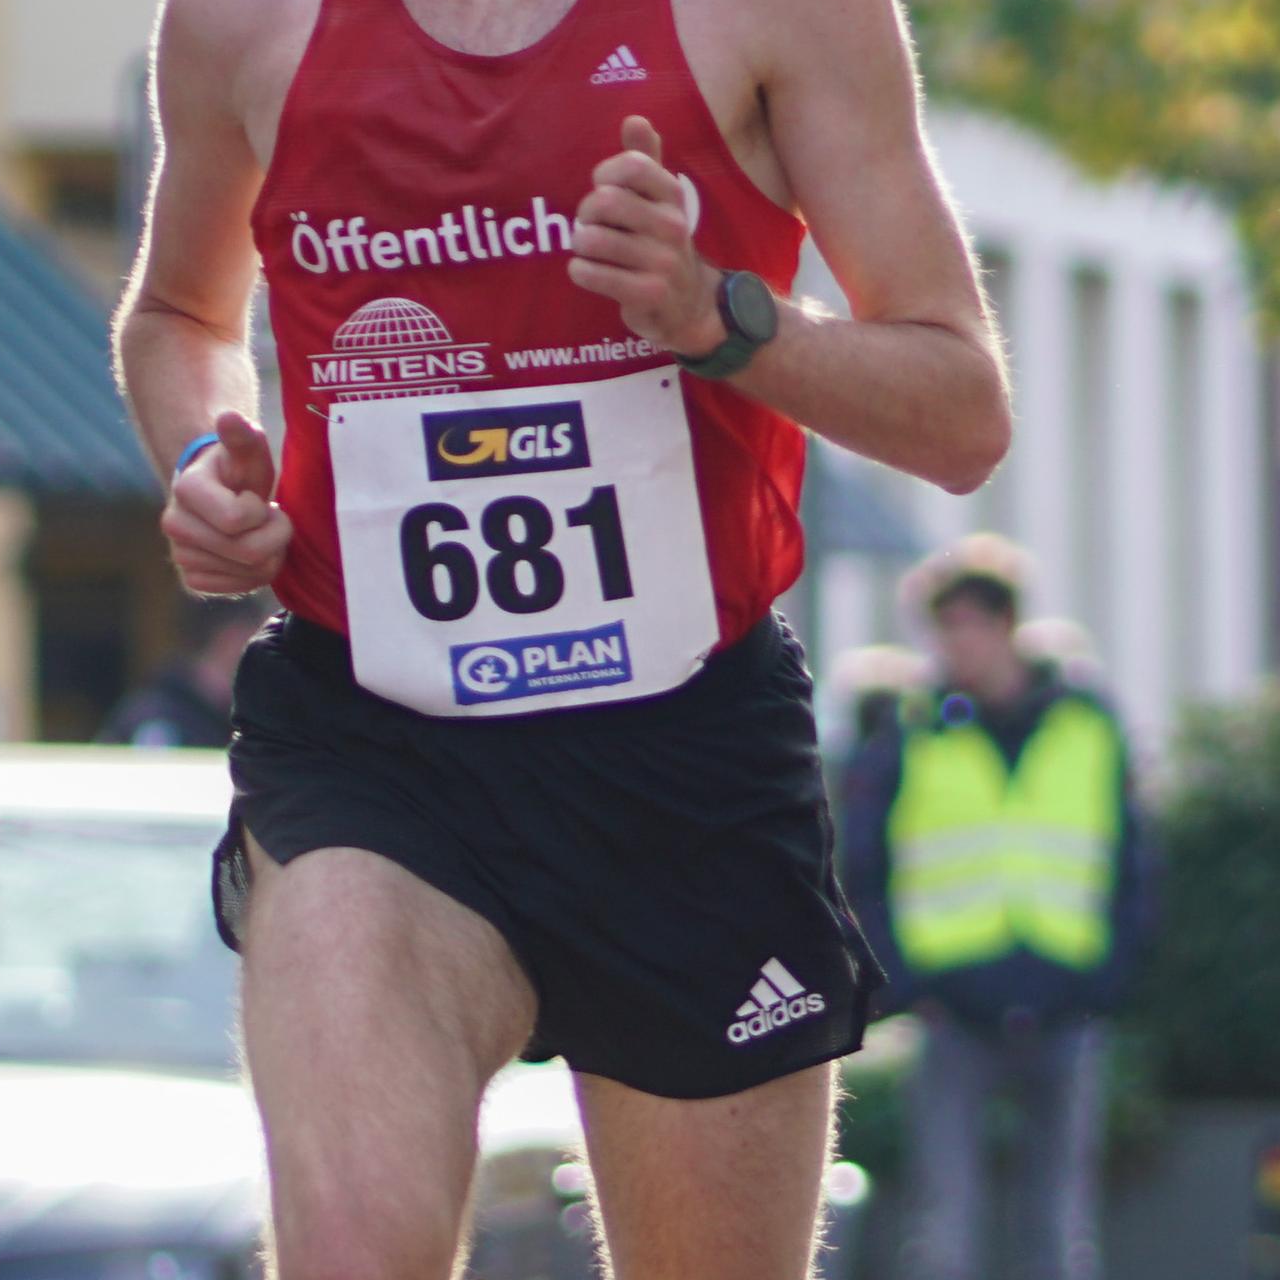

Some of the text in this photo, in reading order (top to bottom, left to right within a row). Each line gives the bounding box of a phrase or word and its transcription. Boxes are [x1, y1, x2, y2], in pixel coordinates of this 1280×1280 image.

[591, 68, 648, 85] adidas
[290, 195, 582, 274] Öffentlich
[311, 350, 488, 385] MIETENS
[509, 422, 574, 460] GLS
[400, 484, 635, 622] 681
[522, 635, 623, 673] PLAN
[527, 666, 625, 688] INTERNATIONAL
[726, 993, 826, 1043] adidas
